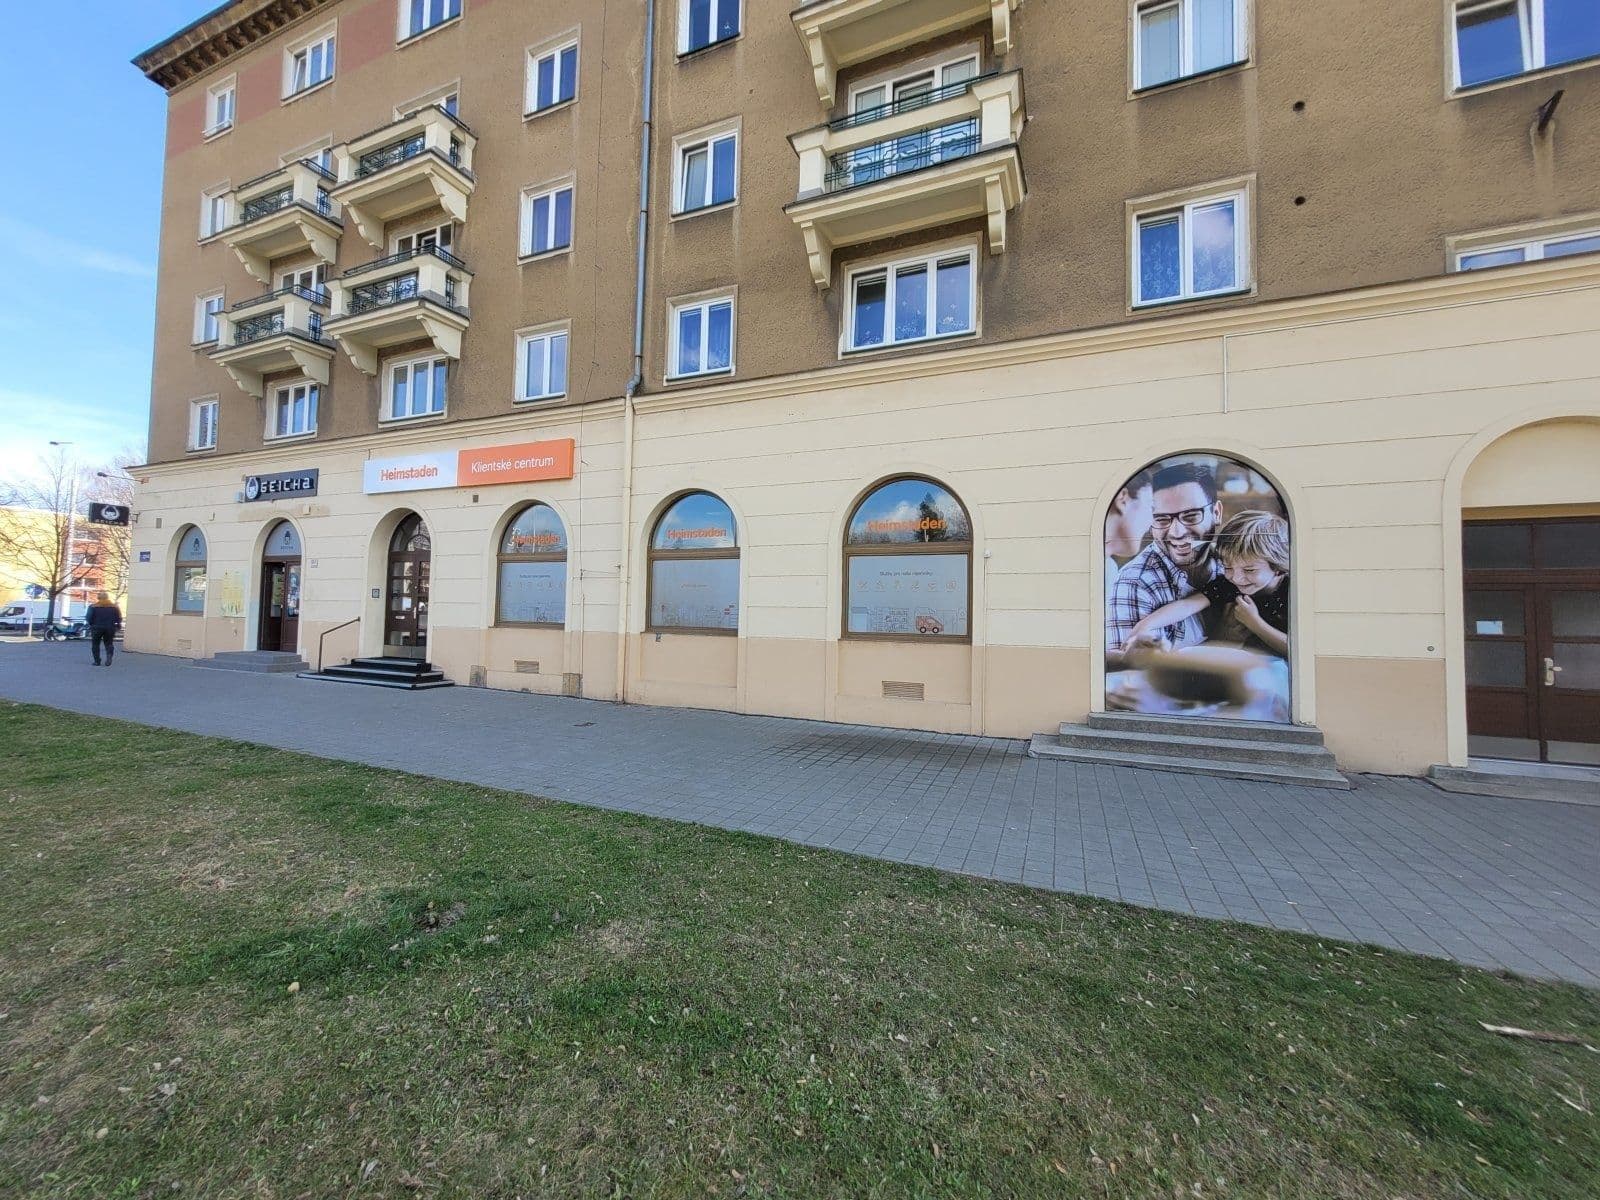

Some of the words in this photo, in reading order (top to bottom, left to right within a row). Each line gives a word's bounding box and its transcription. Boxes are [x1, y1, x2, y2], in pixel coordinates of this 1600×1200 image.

[380, 464, 439, 482] Heimstaden
[471, 458, 512, 474] Klientské
[514, 455, 555, 469] centrum
[667, 527, 727, 540] Heimstaden
